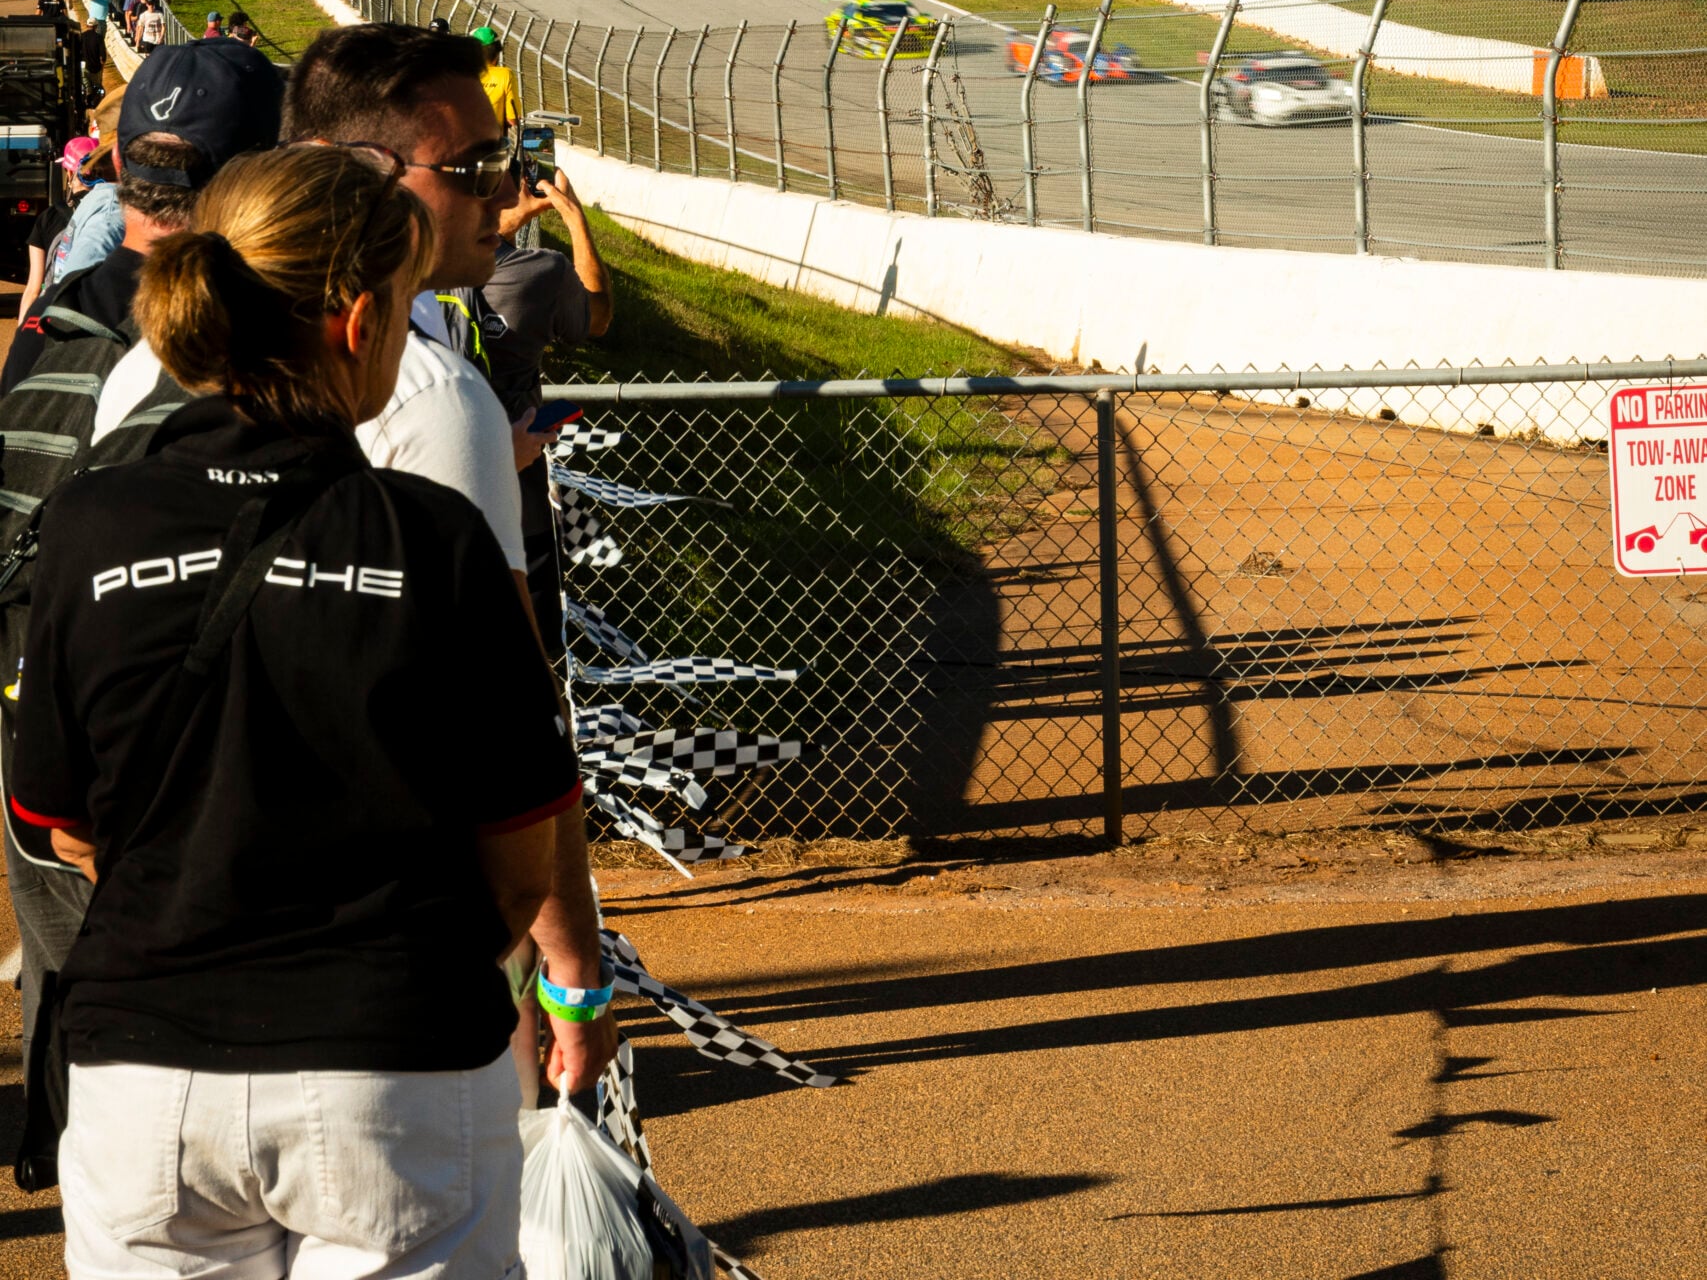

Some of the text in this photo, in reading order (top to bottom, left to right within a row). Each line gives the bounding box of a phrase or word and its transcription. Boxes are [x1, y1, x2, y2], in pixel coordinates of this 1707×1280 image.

[1617, 396, 1643, 422] NO
[1655, 474, 1696, 500] ZONE
[93, 548, 404, 601] PORCHE
